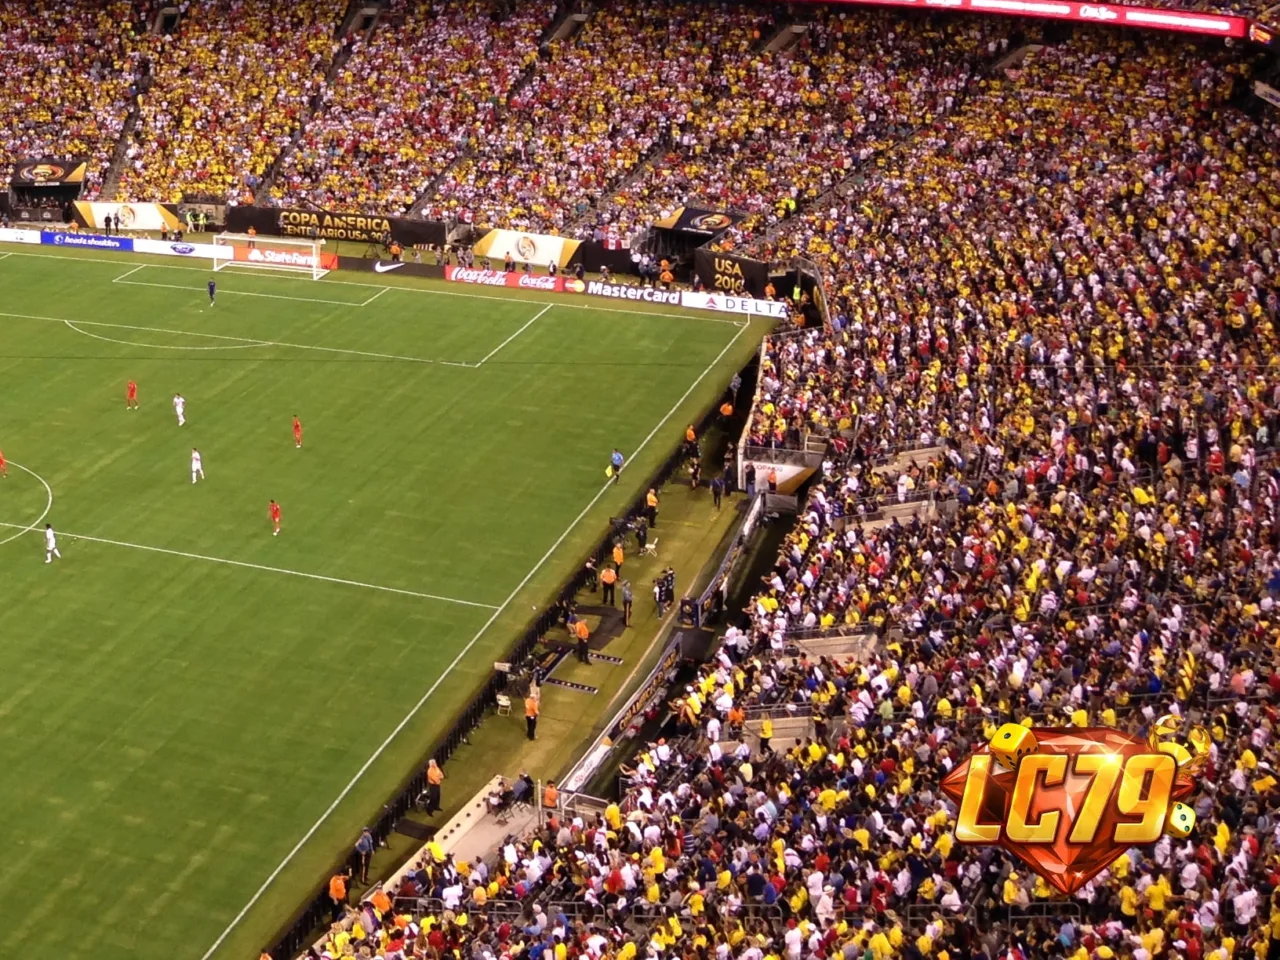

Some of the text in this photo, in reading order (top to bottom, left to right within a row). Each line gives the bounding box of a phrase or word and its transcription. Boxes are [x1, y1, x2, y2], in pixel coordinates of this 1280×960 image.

[280, 212, 392, 232] COPA AMERICA
[714, 258, 742, 277] USA
[587, 281, 680, 304] MasterCard
[714, 274, 742, 292] 2016
[725, 298, 789, 317] DELTA
